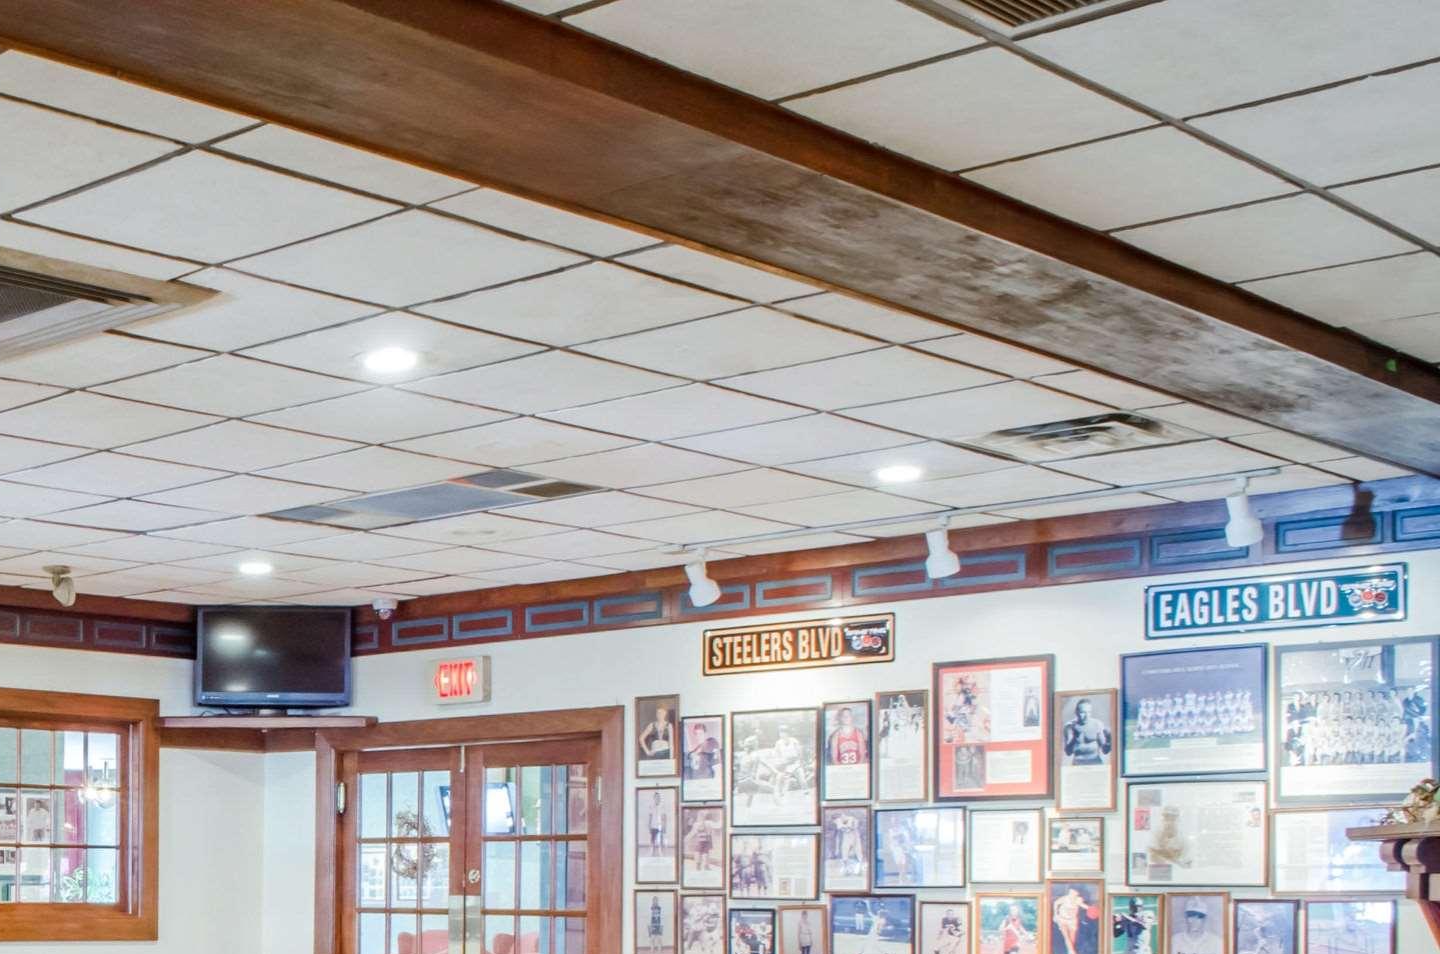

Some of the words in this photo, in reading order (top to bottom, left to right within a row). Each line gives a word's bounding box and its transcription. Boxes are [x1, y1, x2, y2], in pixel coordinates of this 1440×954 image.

[1159, 586, 1258, 628] EAGLES
[1268, 580, 1339, 619] BLVD
[712, 630, 794, 668] STEELERS
[797, 626, 844, 660] BLVD
[439, 662, 473, 697] EXIT
